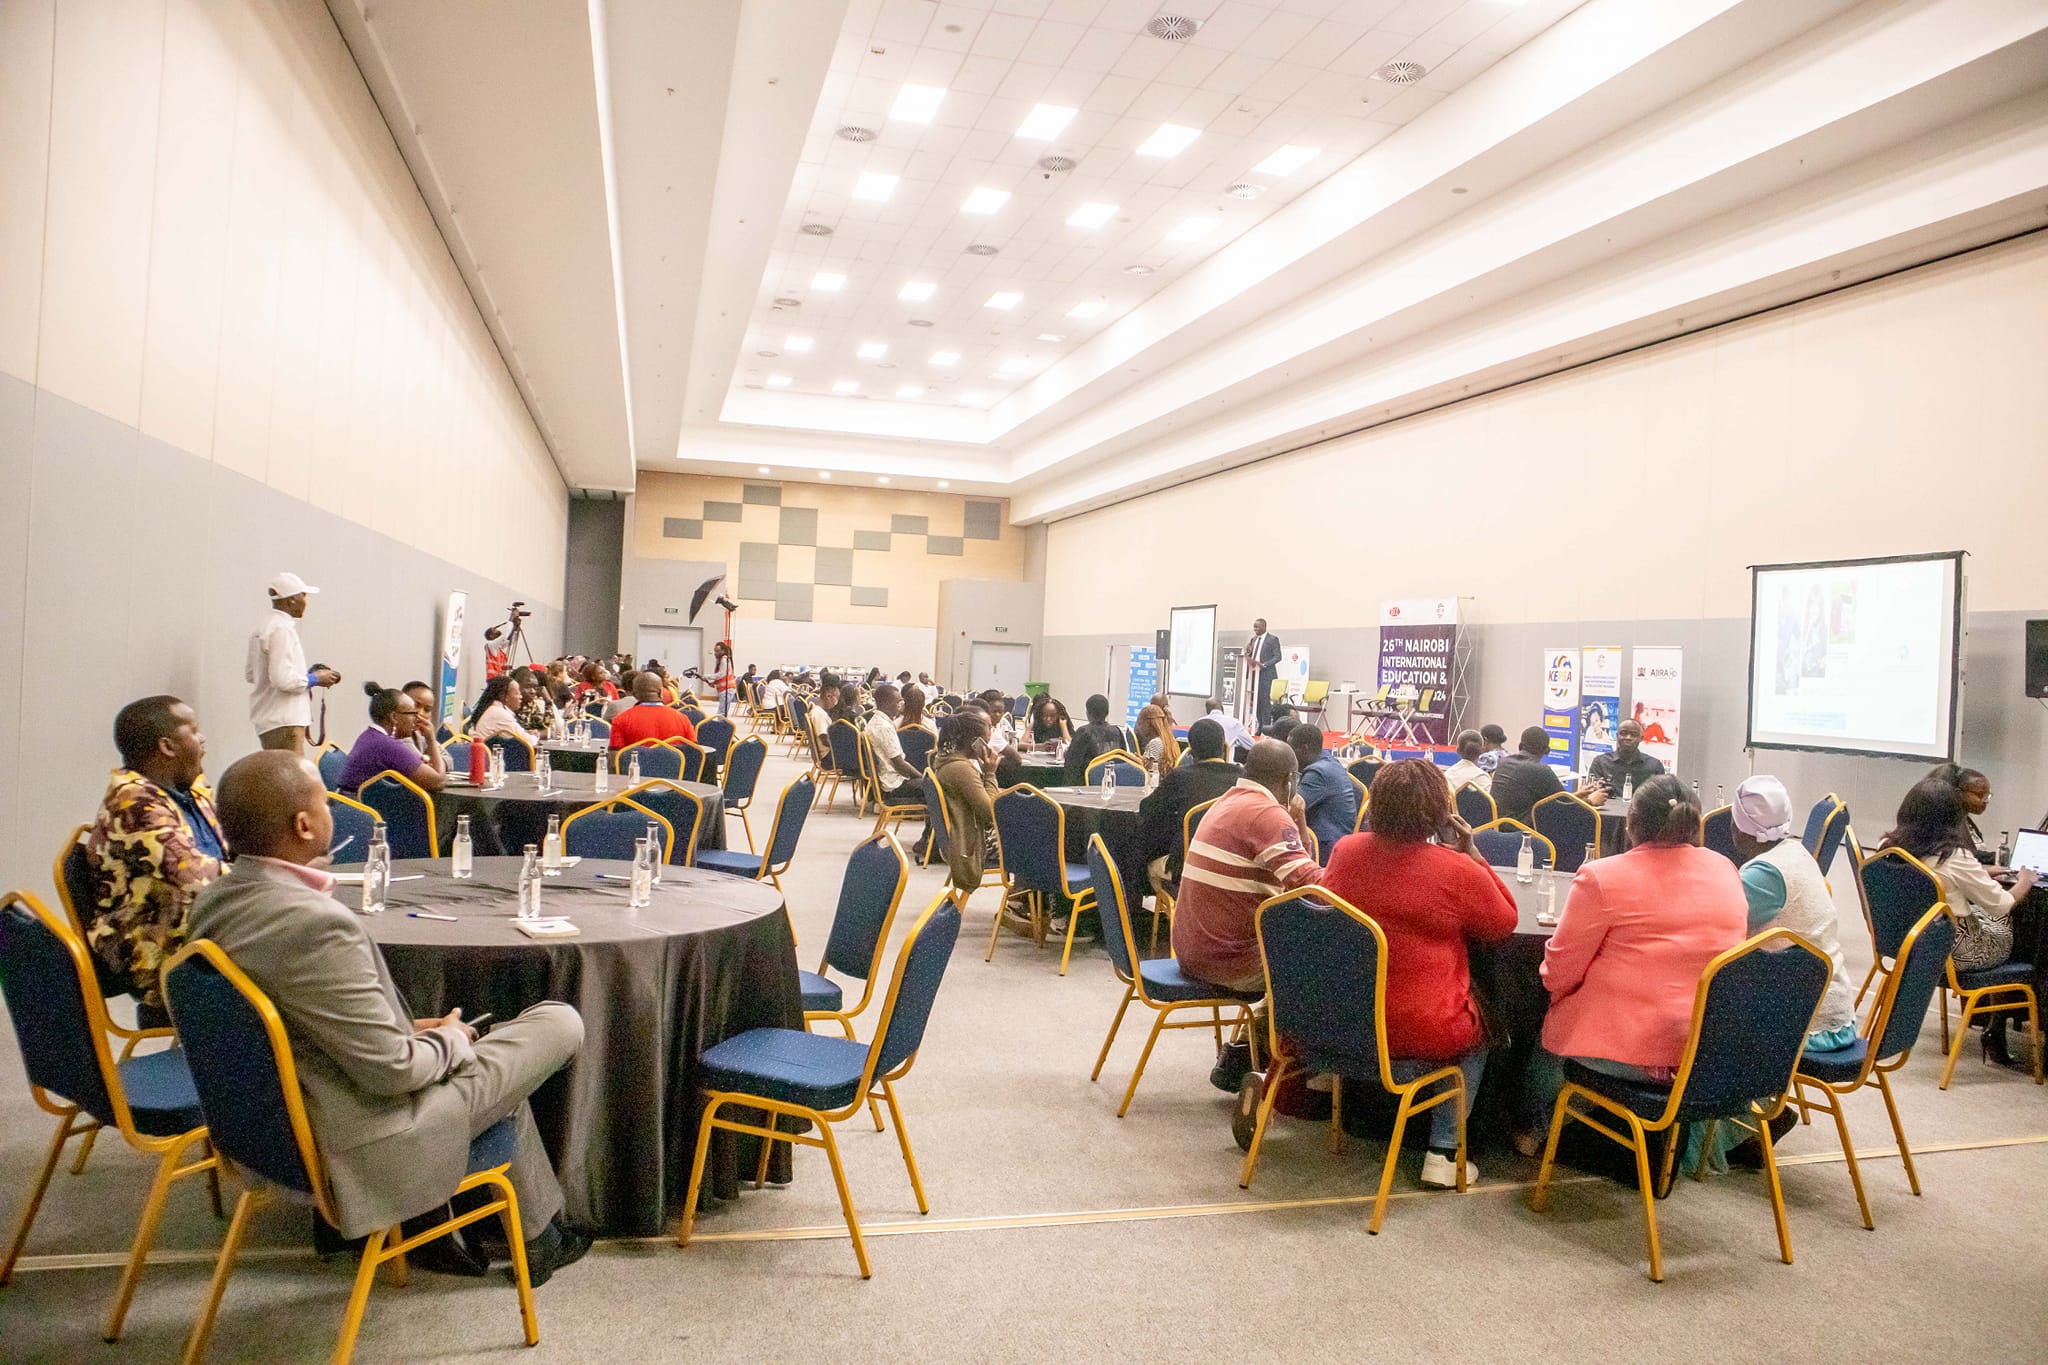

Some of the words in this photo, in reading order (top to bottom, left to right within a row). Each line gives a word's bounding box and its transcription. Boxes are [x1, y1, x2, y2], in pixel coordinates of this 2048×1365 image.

[1382, 638, 1403, 653] 26TH
[1405, 639, 1449, 653] NAIROBI
[1382, 656, 1447, 669] INTERNATIONAL
[1382, 669, 1437, 684] EDUCATION
[1439, 672, 1447, 685] &
[1548, 670, 1572, 683] KEPSA
